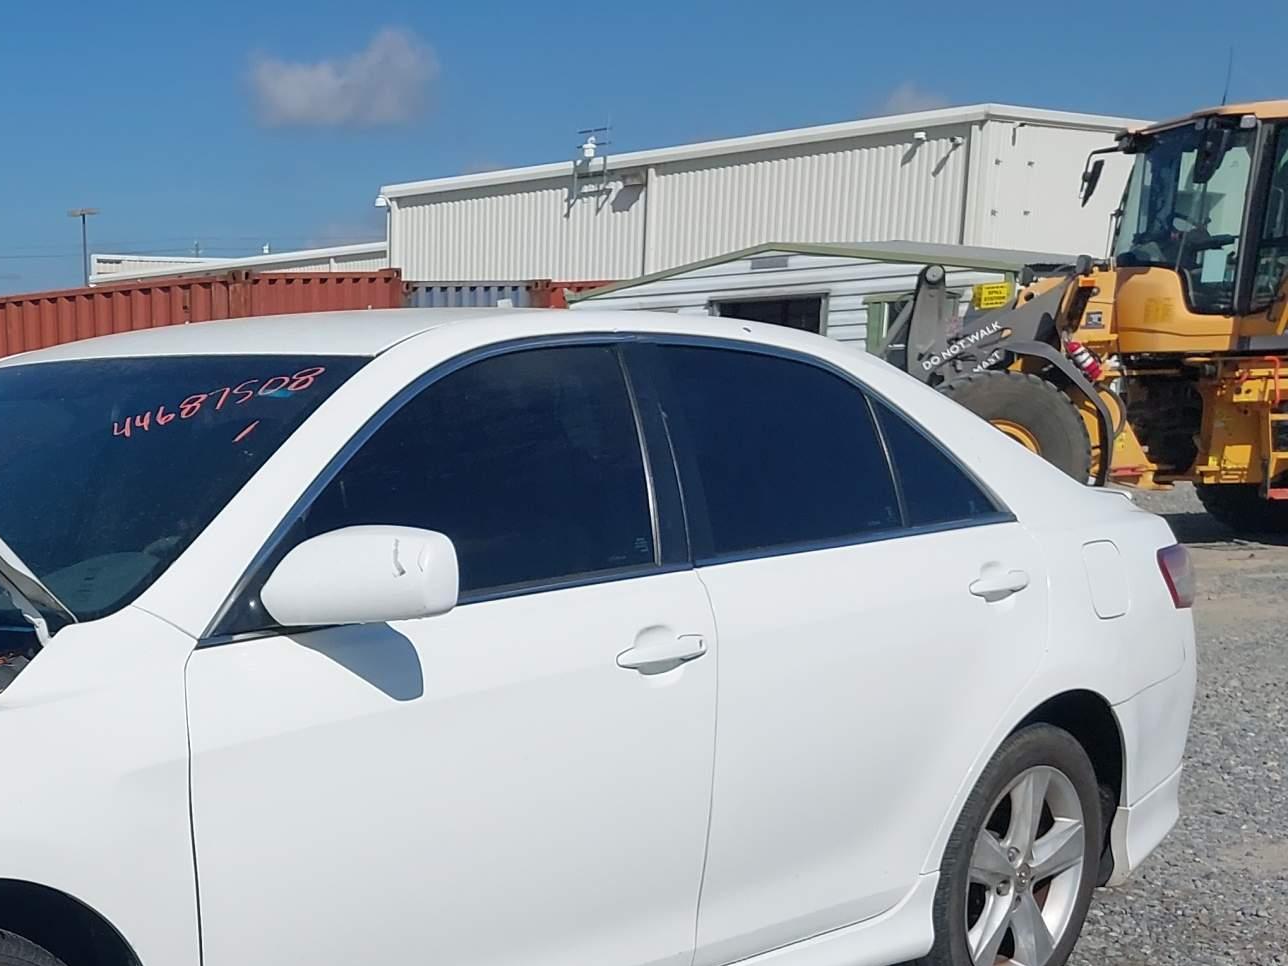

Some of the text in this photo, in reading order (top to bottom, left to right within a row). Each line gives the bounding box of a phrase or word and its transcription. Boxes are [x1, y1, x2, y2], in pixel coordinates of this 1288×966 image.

[922, 321, 1002, 371] DO NOT WALK
[113, 366, 326, 438] 44687508
